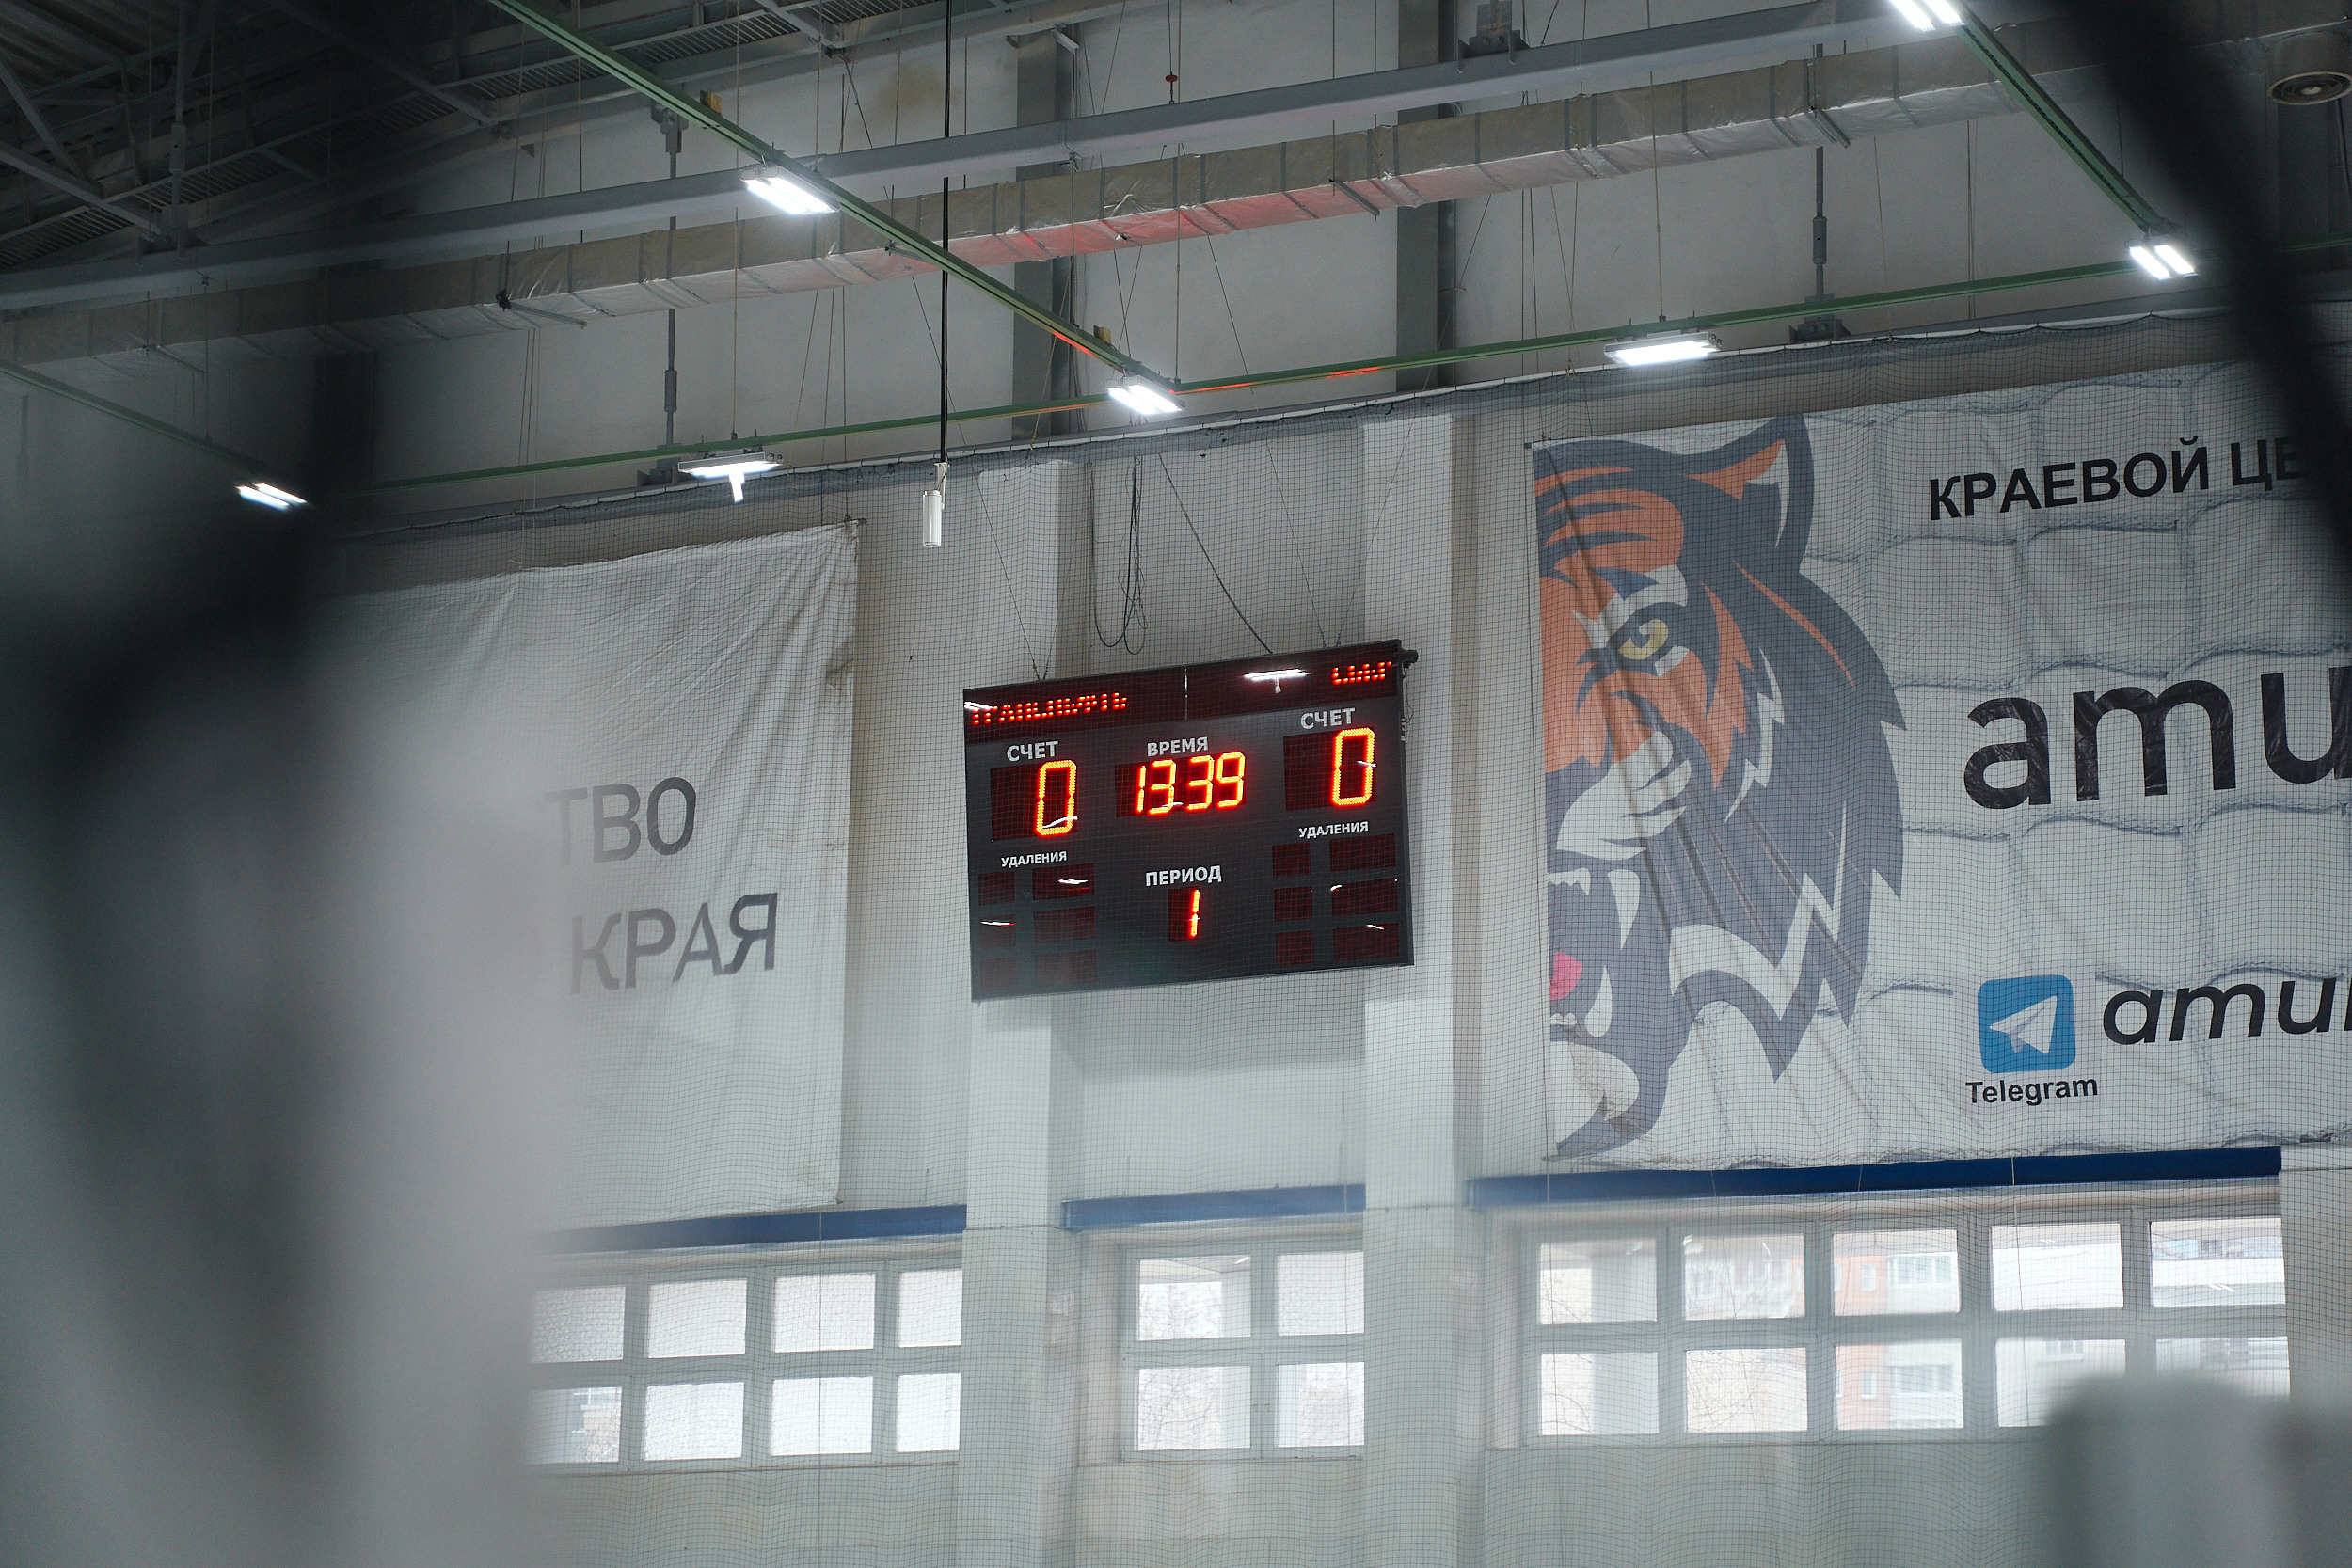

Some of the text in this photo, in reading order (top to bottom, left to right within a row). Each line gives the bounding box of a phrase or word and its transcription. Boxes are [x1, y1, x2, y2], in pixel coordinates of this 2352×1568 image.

[1930, 436, 2209, 521] КРАЕВОЙ
[1300, 707, 1356, 730] СЧЕТ
[1007, 740, 1059, 762] СЧЕТ
[1146, 736, 1209, 757] ВРЕМЯ
[1331, 727, 1375, 807] 0
[1035, 759, 1077, 836] 0
[1298, 820, 1369, 839] УДАЛЕНИЯ
[1000, 850, 1068, 869] УДАЛЕНИЯ
[1145, 865, 1222, 887] ПЕРИОД
[1188, 889, 1200, 939] 1
[2103, 977, 2352, 1046] amu
[1965, 1076, 2099, 1106] Telegram
